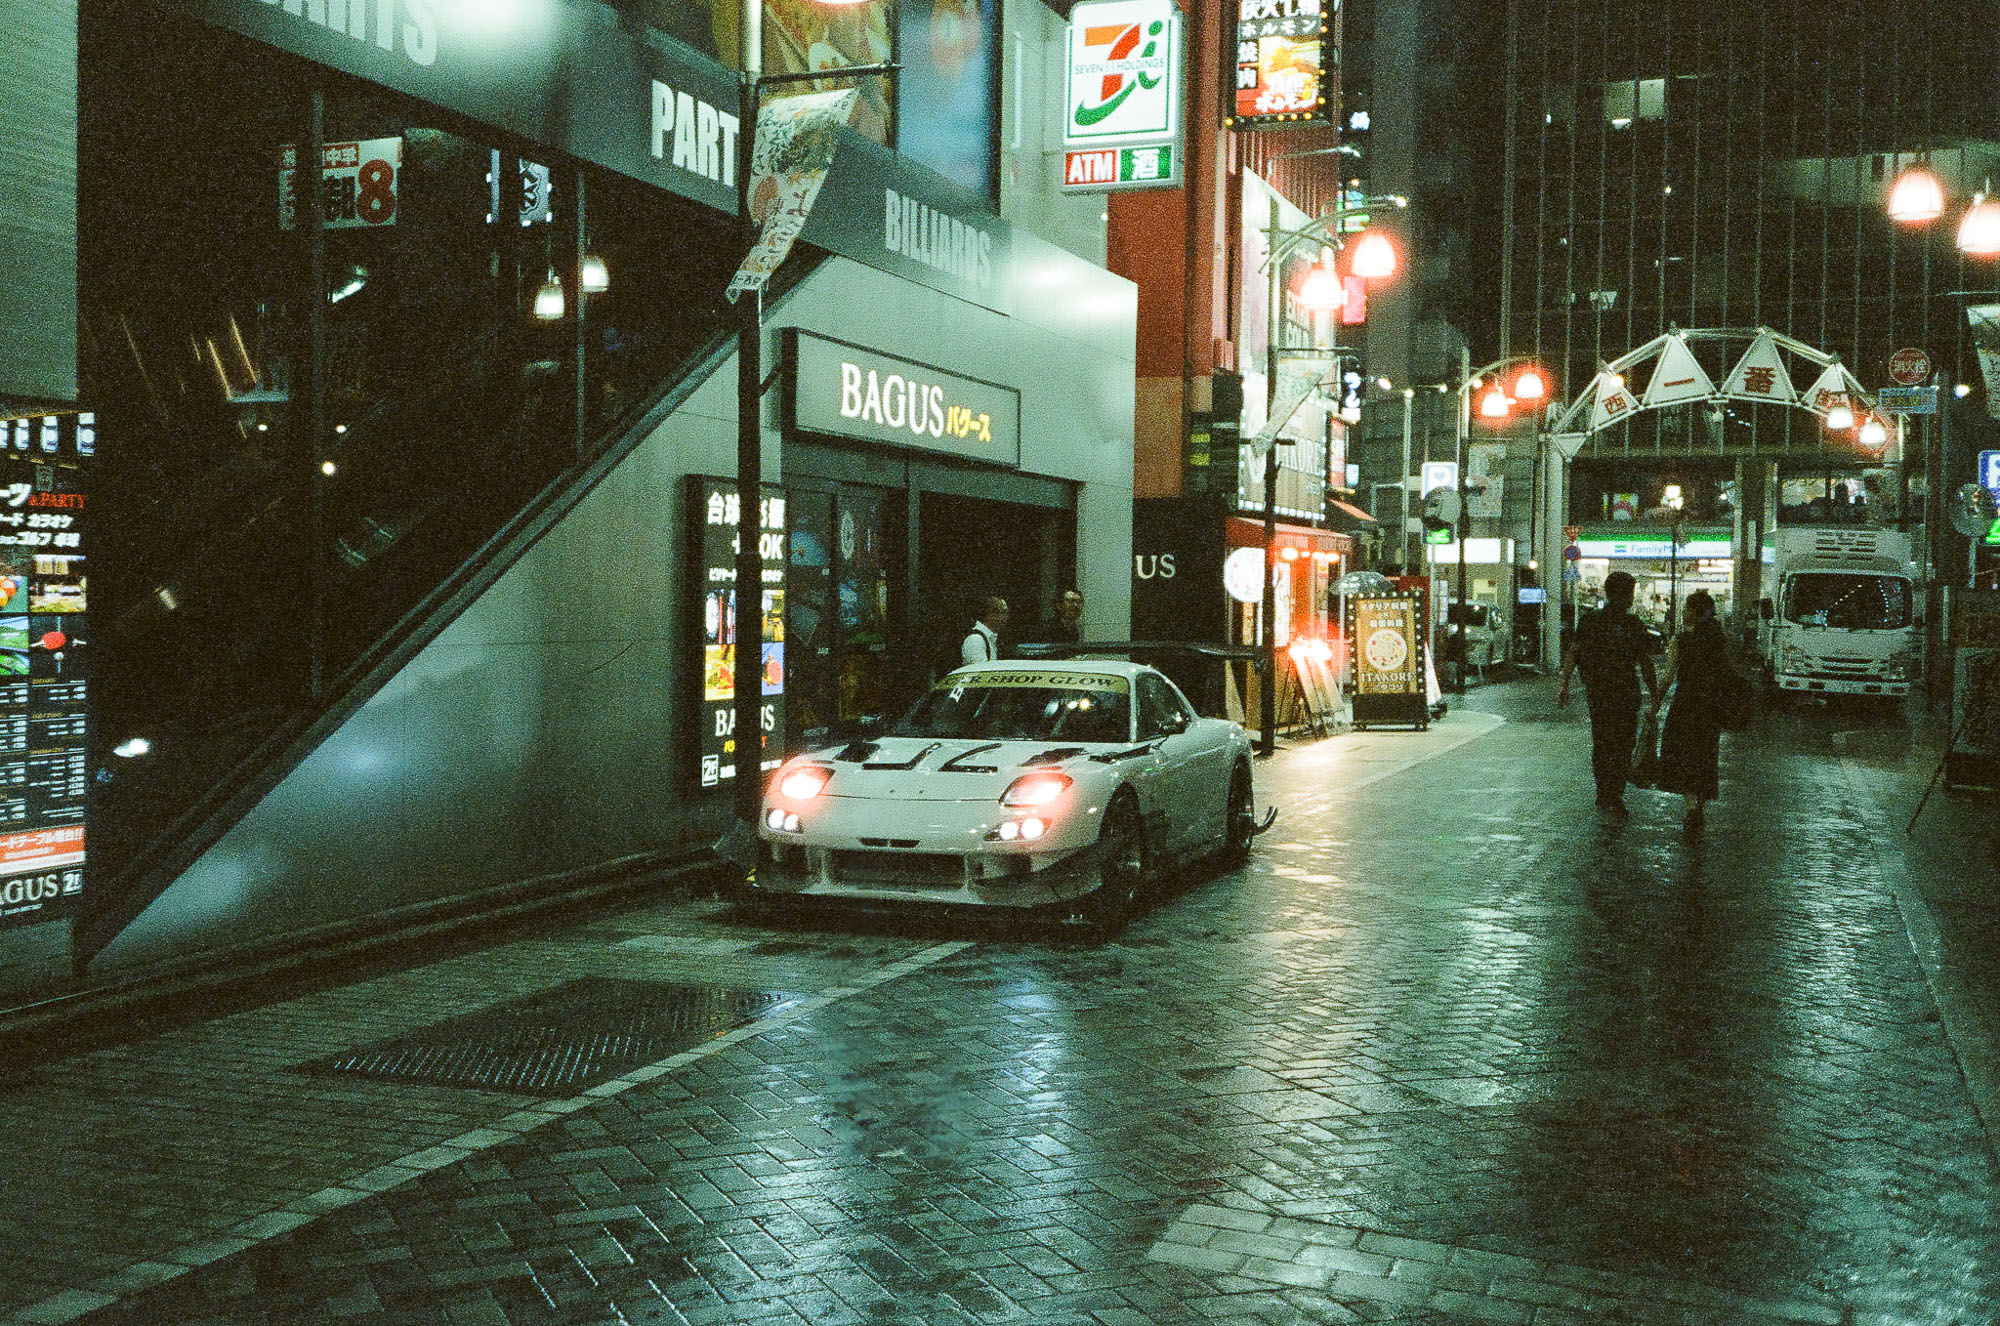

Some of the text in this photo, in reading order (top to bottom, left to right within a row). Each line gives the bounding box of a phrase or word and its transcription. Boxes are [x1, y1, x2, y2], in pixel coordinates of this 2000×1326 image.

[1241, 20, 1318, 37] ホルモン
[1074, 63, 1103, 74] SEVEN
[1117, 58, 1164, 71] HOLDINGS
[1068, 151, 1114, 183] ATM
[1132, 148, 1160, 180] 酒
[885, 187, 993, 288] BILLIARDS
[841, 362, 945, 438] BAGUS
[946, 405, 992, 443] バグース
[1631, 543, 1687, 554] FamilyMrt
[1136, 553, 1176, 579] US
[988, 674, 1042, 684] SHOP
[1049, 676, 1115, 688] GLOW
[1361, 672, 1417, 683] ITAKORE
